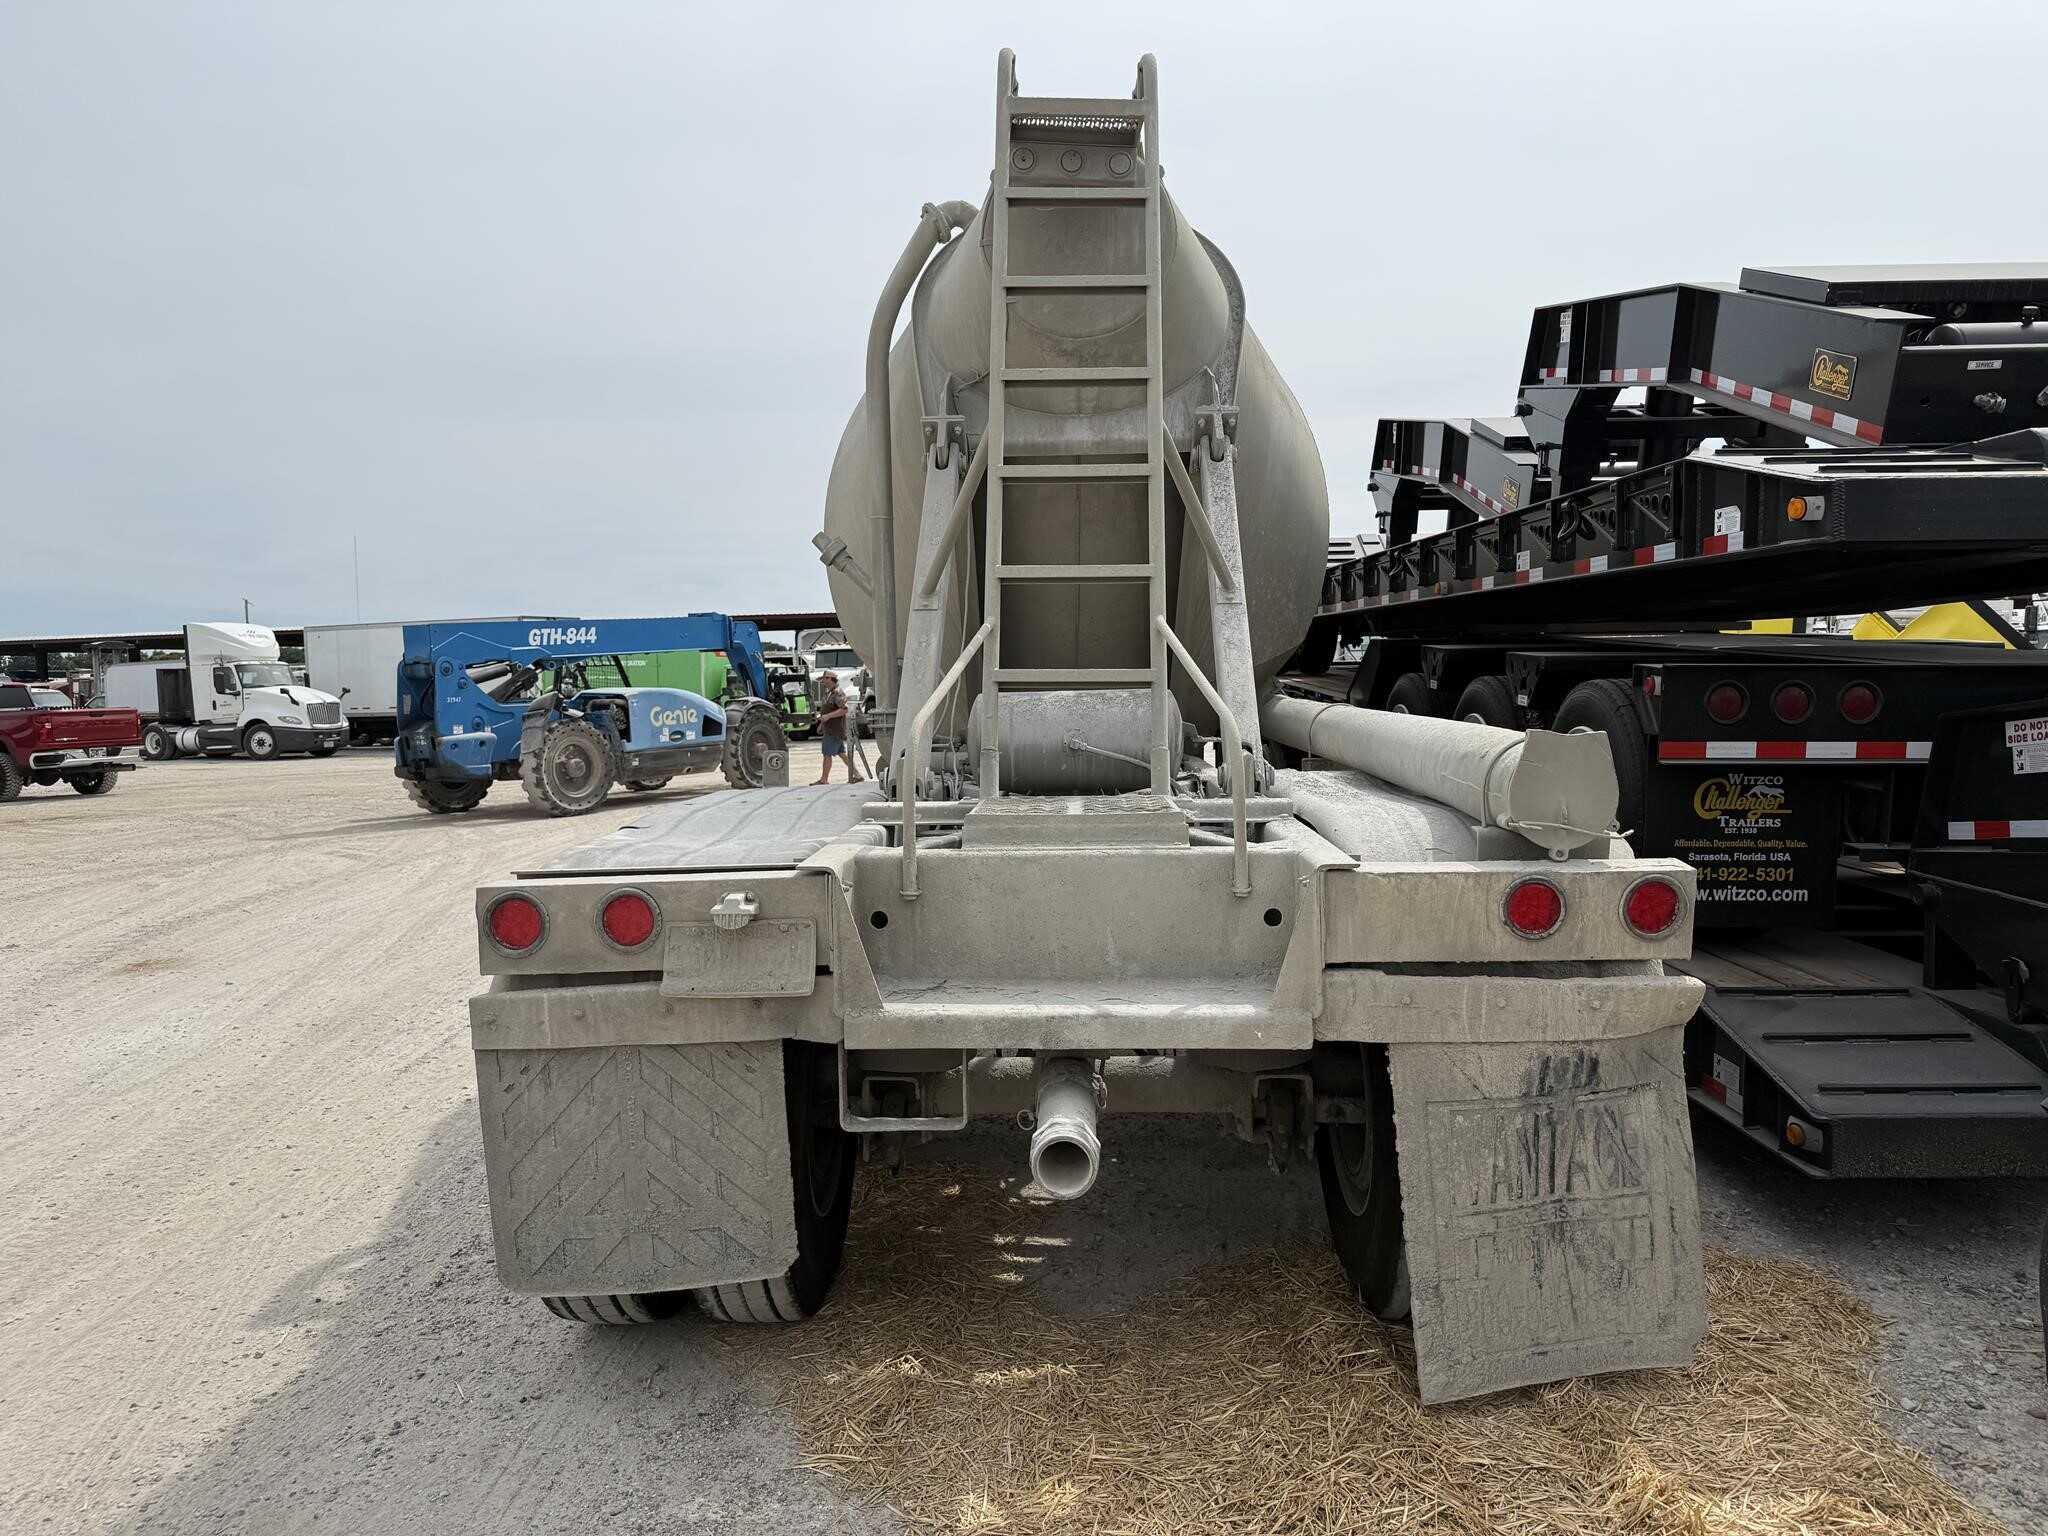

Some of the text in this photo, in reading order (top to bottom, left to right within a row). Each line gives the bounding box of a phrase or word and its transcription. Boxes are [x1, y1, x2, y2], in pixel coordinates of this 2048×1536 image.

[528, 627, 597, 646] GTH-844
[651, 705, 698, 727] Genie
[2013, 720, 2048, 733] DO NOT
[2007, 733, 2029, 744] SIDE
[1728, 772, 1784, 785] WITZCO
[1694, 777, 1793, 820] Challenger
[1717, 815, 1782, 828] TRAILERS
[1688, 852, 1791, 862] Sarasota, Florida USA
[1696, 867, 1794, 882] 41-922-5301
[1694, 885, 1809, 902] w.witzco.com
